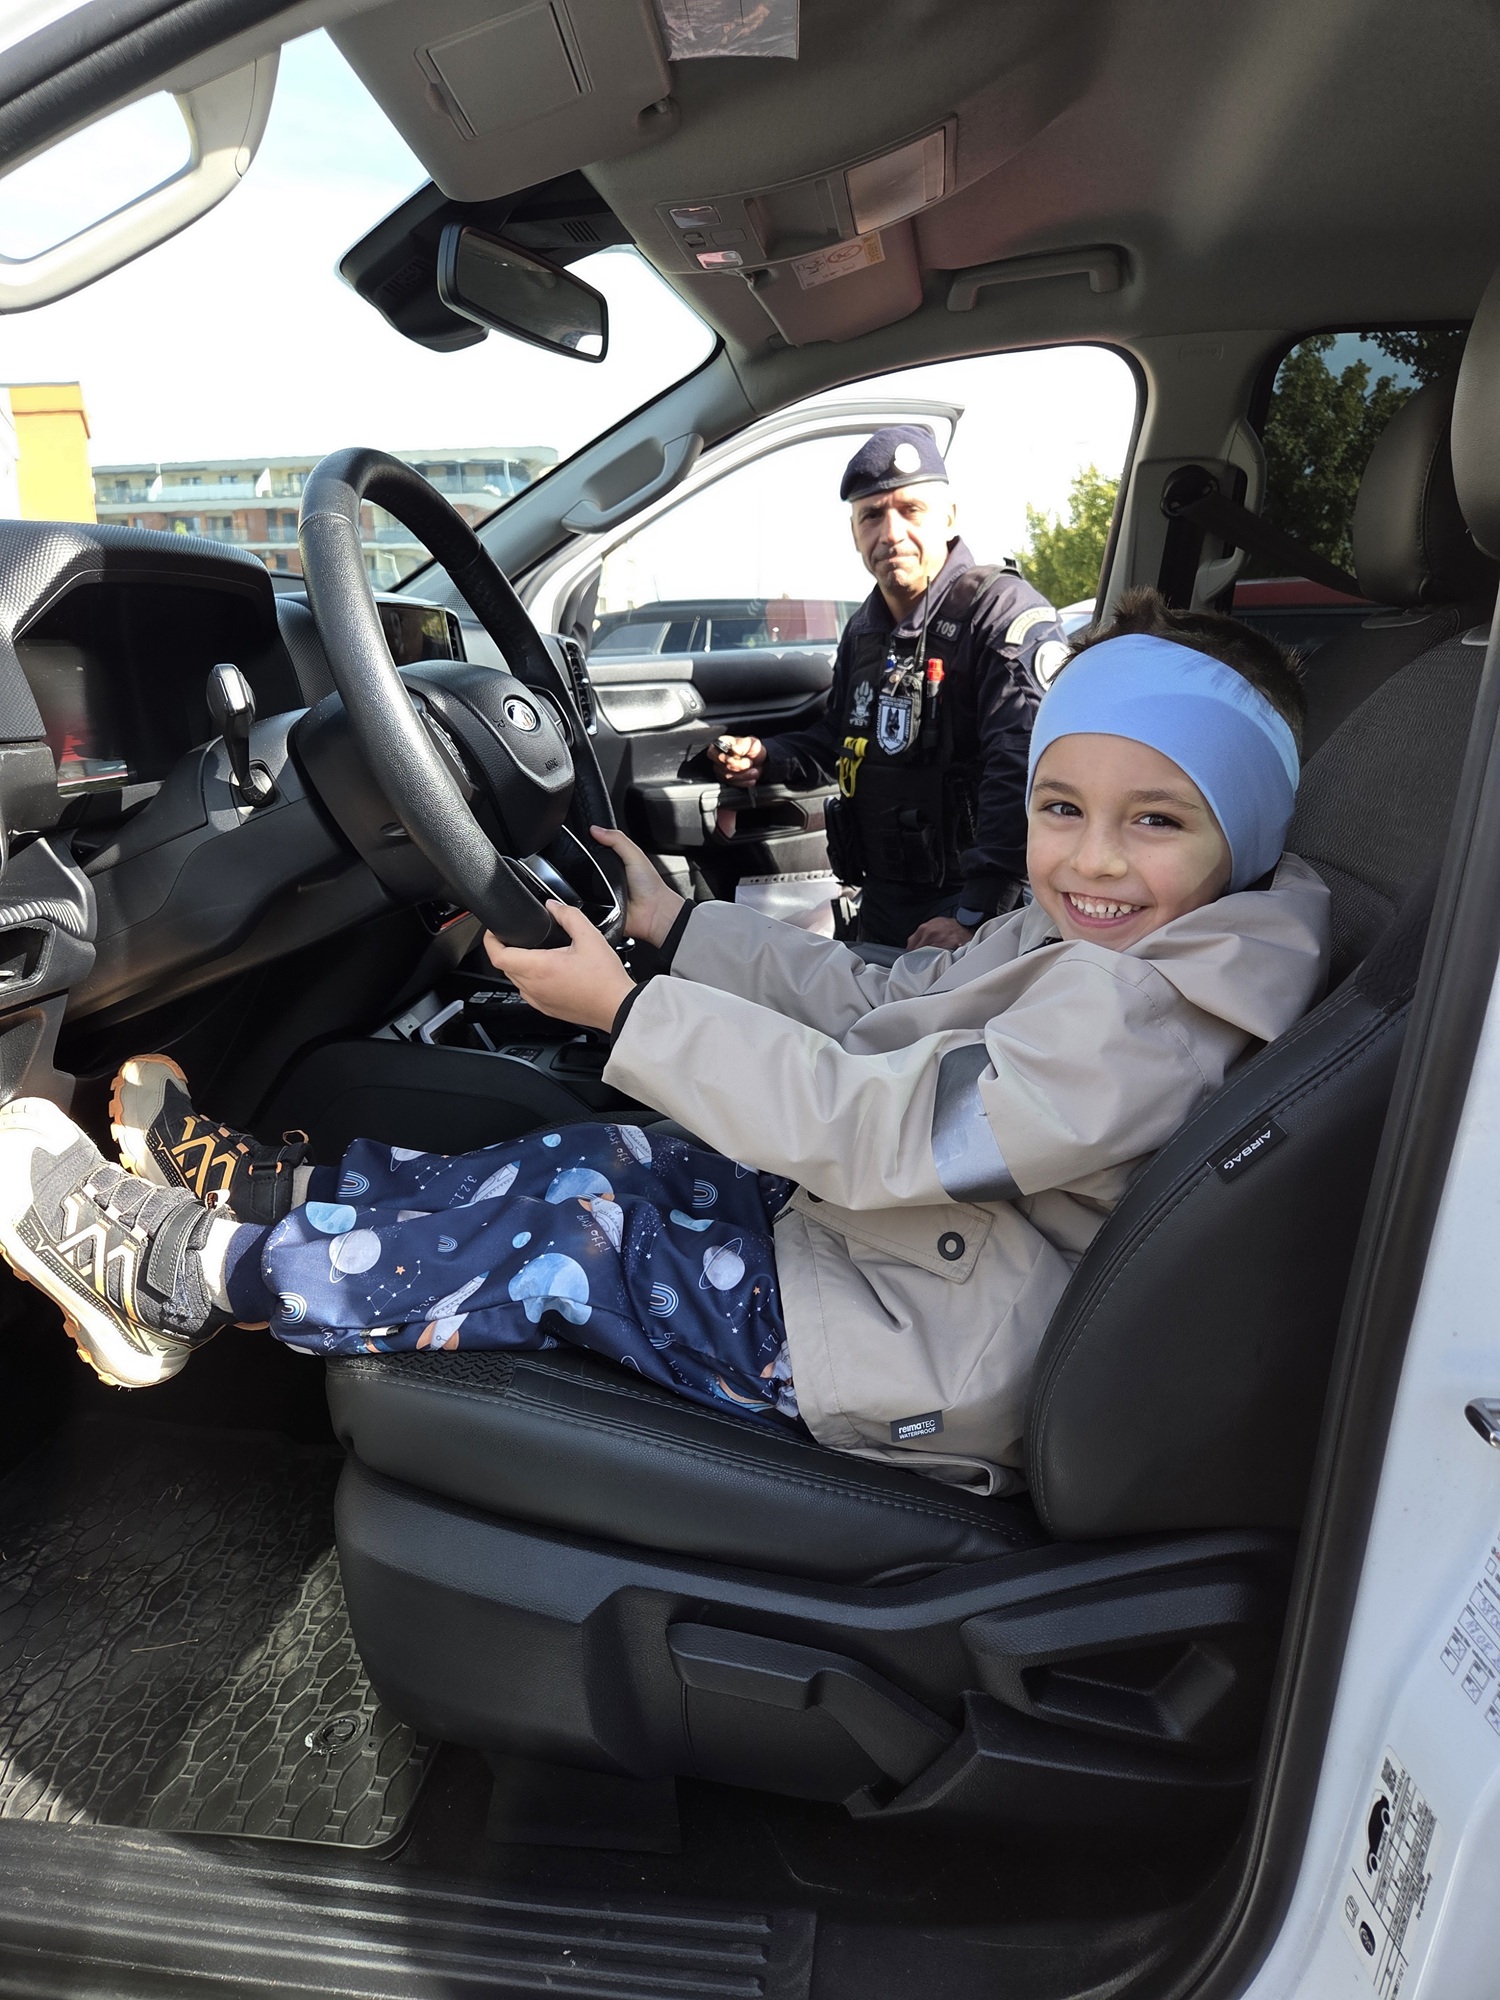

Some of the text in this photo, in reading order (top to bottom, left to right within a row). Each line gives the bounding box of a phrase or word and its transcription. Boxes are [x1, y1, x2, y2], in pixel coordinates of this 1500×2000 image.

[936, 619, 956, 637] 109
[1223, 1129, 1271, 1170] AIRBAG
[590, 1229, 612, 1253] off!
[898, 1426, 937, 1440] WATERPROOF
